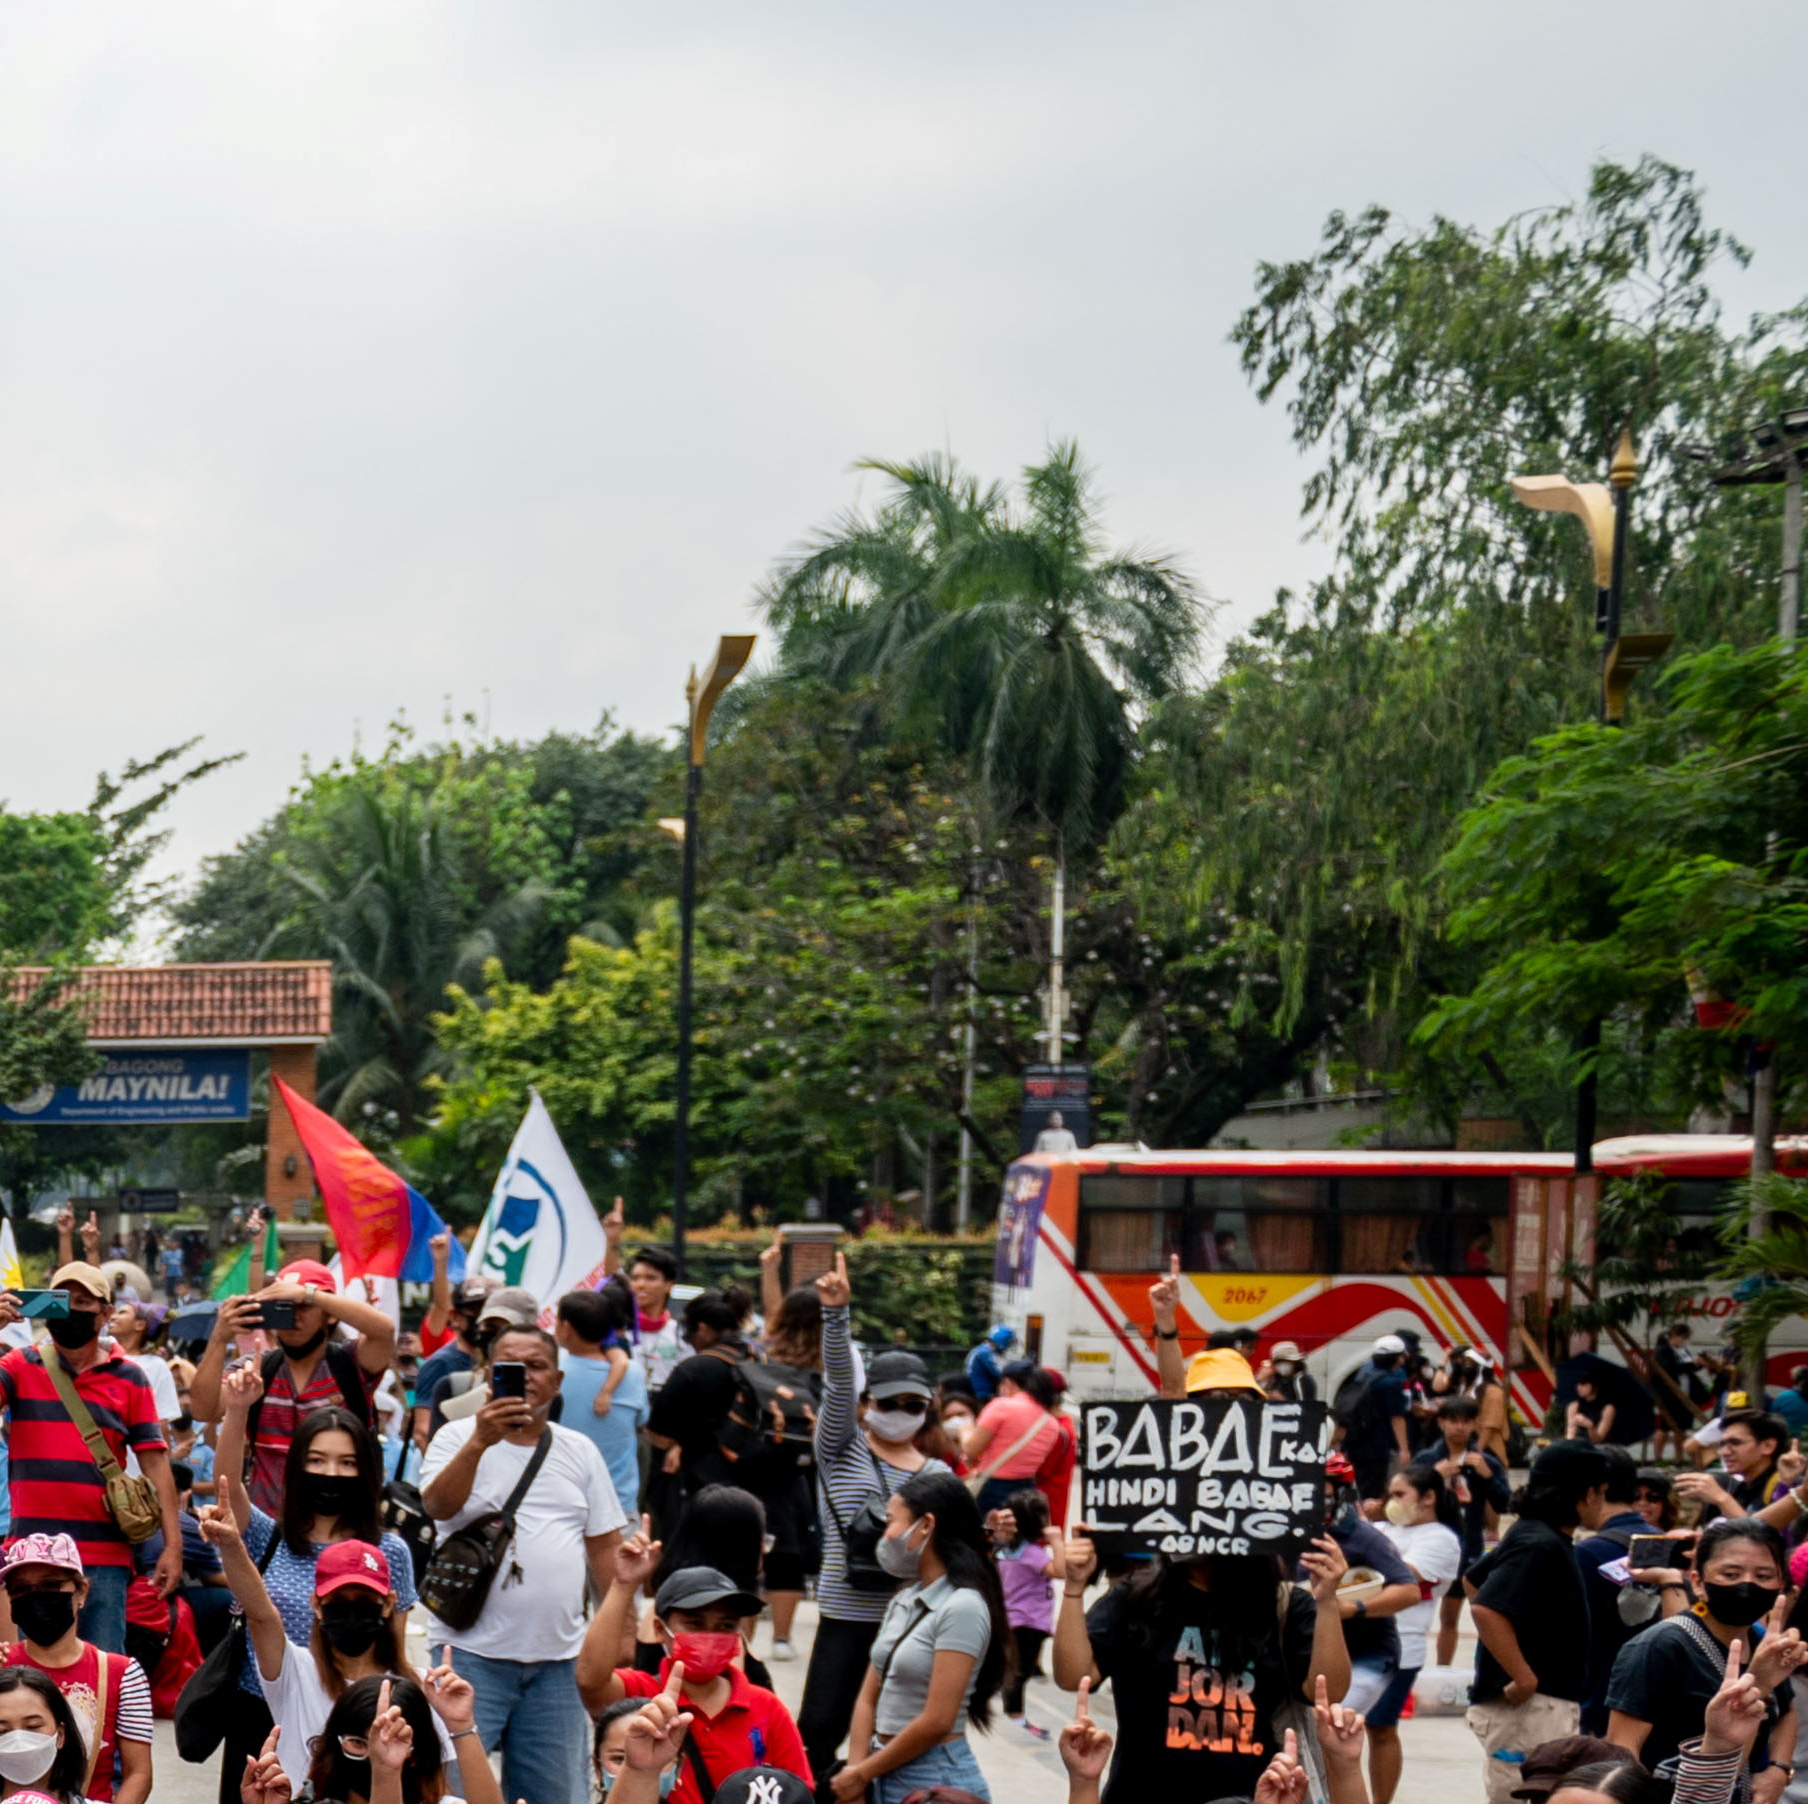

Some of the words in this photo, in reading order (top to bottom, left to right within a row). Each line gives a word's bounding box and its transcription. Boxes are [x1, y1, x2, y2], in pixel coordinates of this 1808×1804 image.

[78, 1074, 231, 1102] MAYNILA!
[1224, 1287, 1267, 1305] 2067
[1086, 1400, 1302, 1479] BABAE
[1086, 1477, 1177, 1507] HINDI
[1196, 1478, 1316, 1515] BABAE
[1086, 1507, 1306, 1541] LANG.
[1168, 1663, 1257, 1712] JOR
